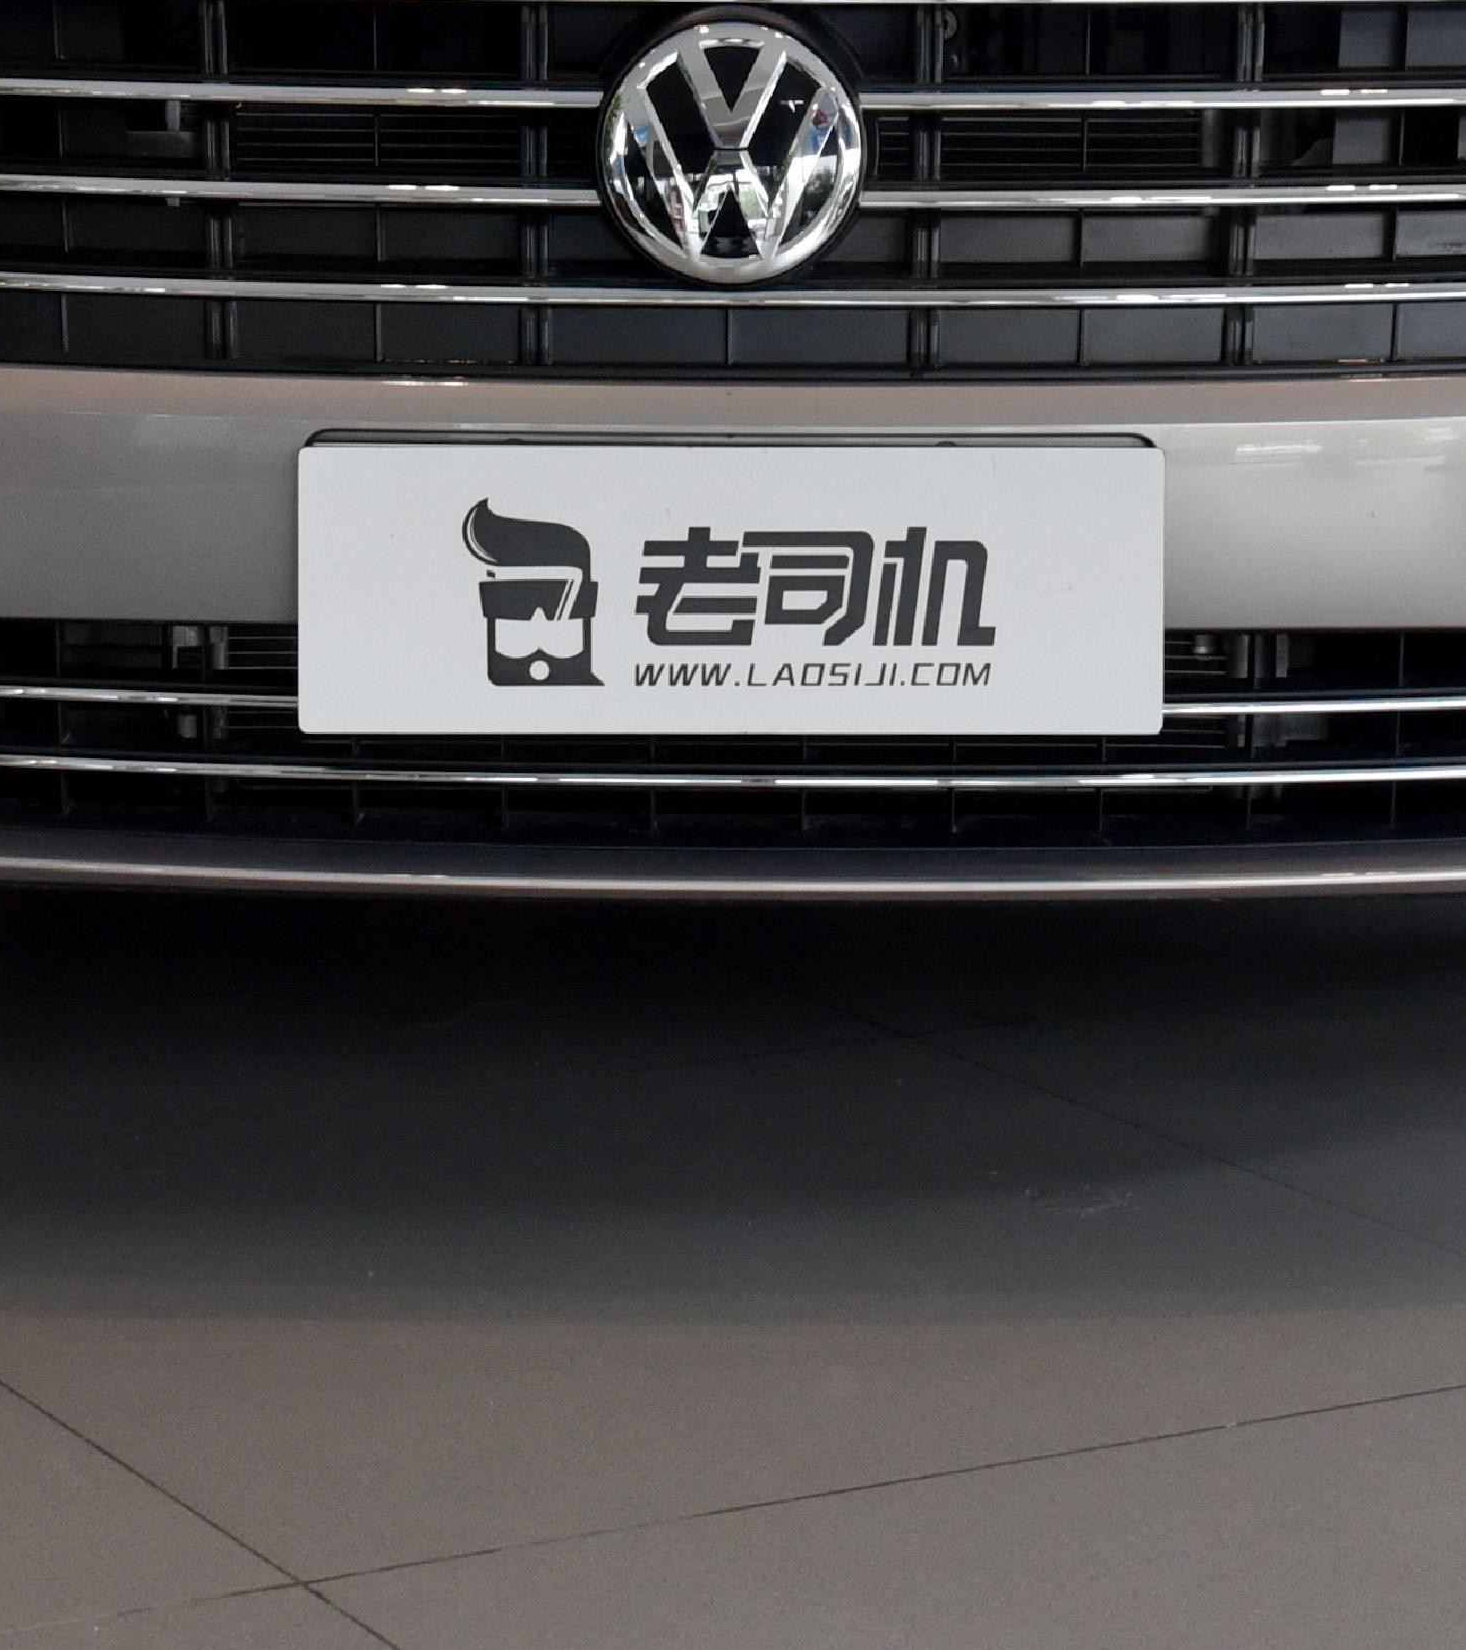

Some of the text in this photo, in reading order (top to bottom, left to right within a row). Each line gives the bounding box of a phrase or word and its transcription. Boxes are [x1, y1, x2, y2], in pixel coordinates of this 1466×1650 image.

[634, 526, 997, 647] 老司机
[634, 661, 992, 688] WWW.LAOSIJI.COM
